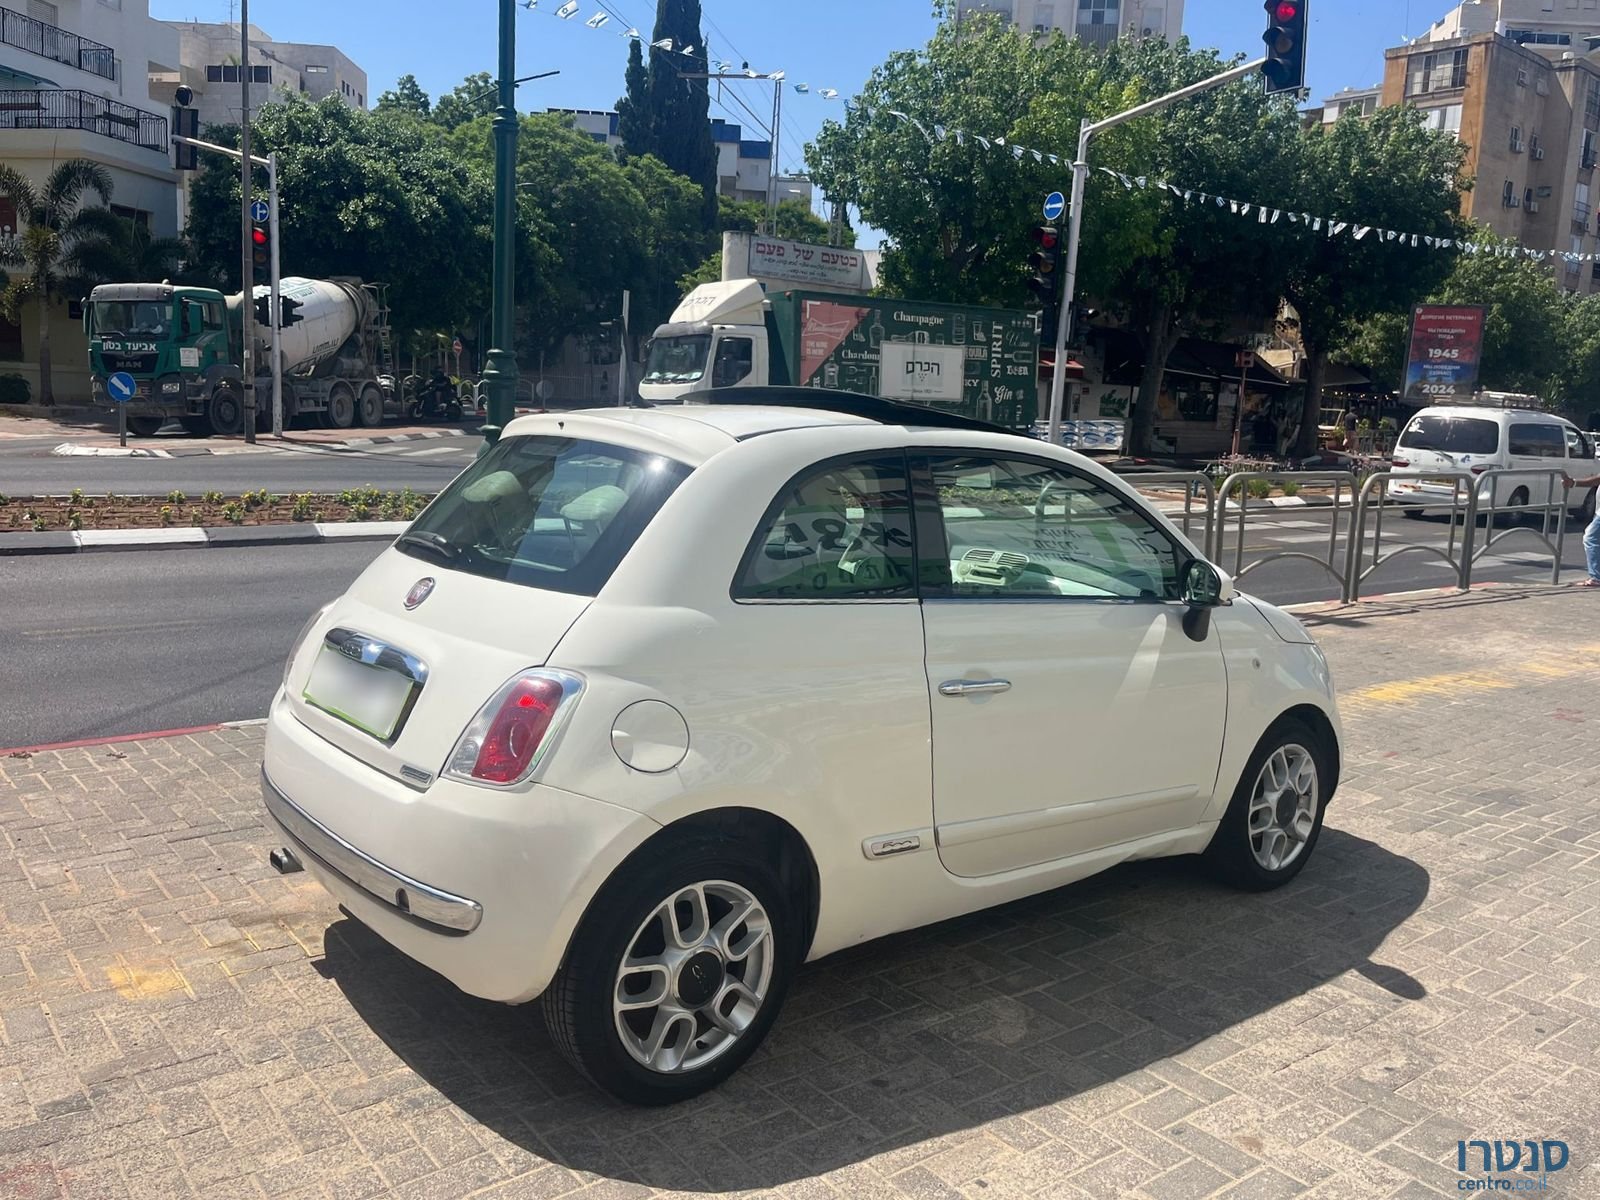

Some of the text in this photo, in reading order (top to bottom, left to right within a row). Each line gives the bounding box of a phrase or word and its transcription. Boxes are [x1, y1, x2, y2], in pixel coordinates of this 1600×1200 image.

[756, 242, 785, 257] פעם
[793, 243, 814, 261] של
[821, 251, 858, 267] בטעם
[893, 311, 944, 326] Champagne
[102, 340, 157, 351] אביעד בטון
[991, 321, 1003, 378] SPIRIT
[1428, 348, 1459, 358] 1945
[905, 361, 940, 376] הכרם
[994, 385, 1013, 404] Gin
[1422, 384, 1456, 394] 2024
